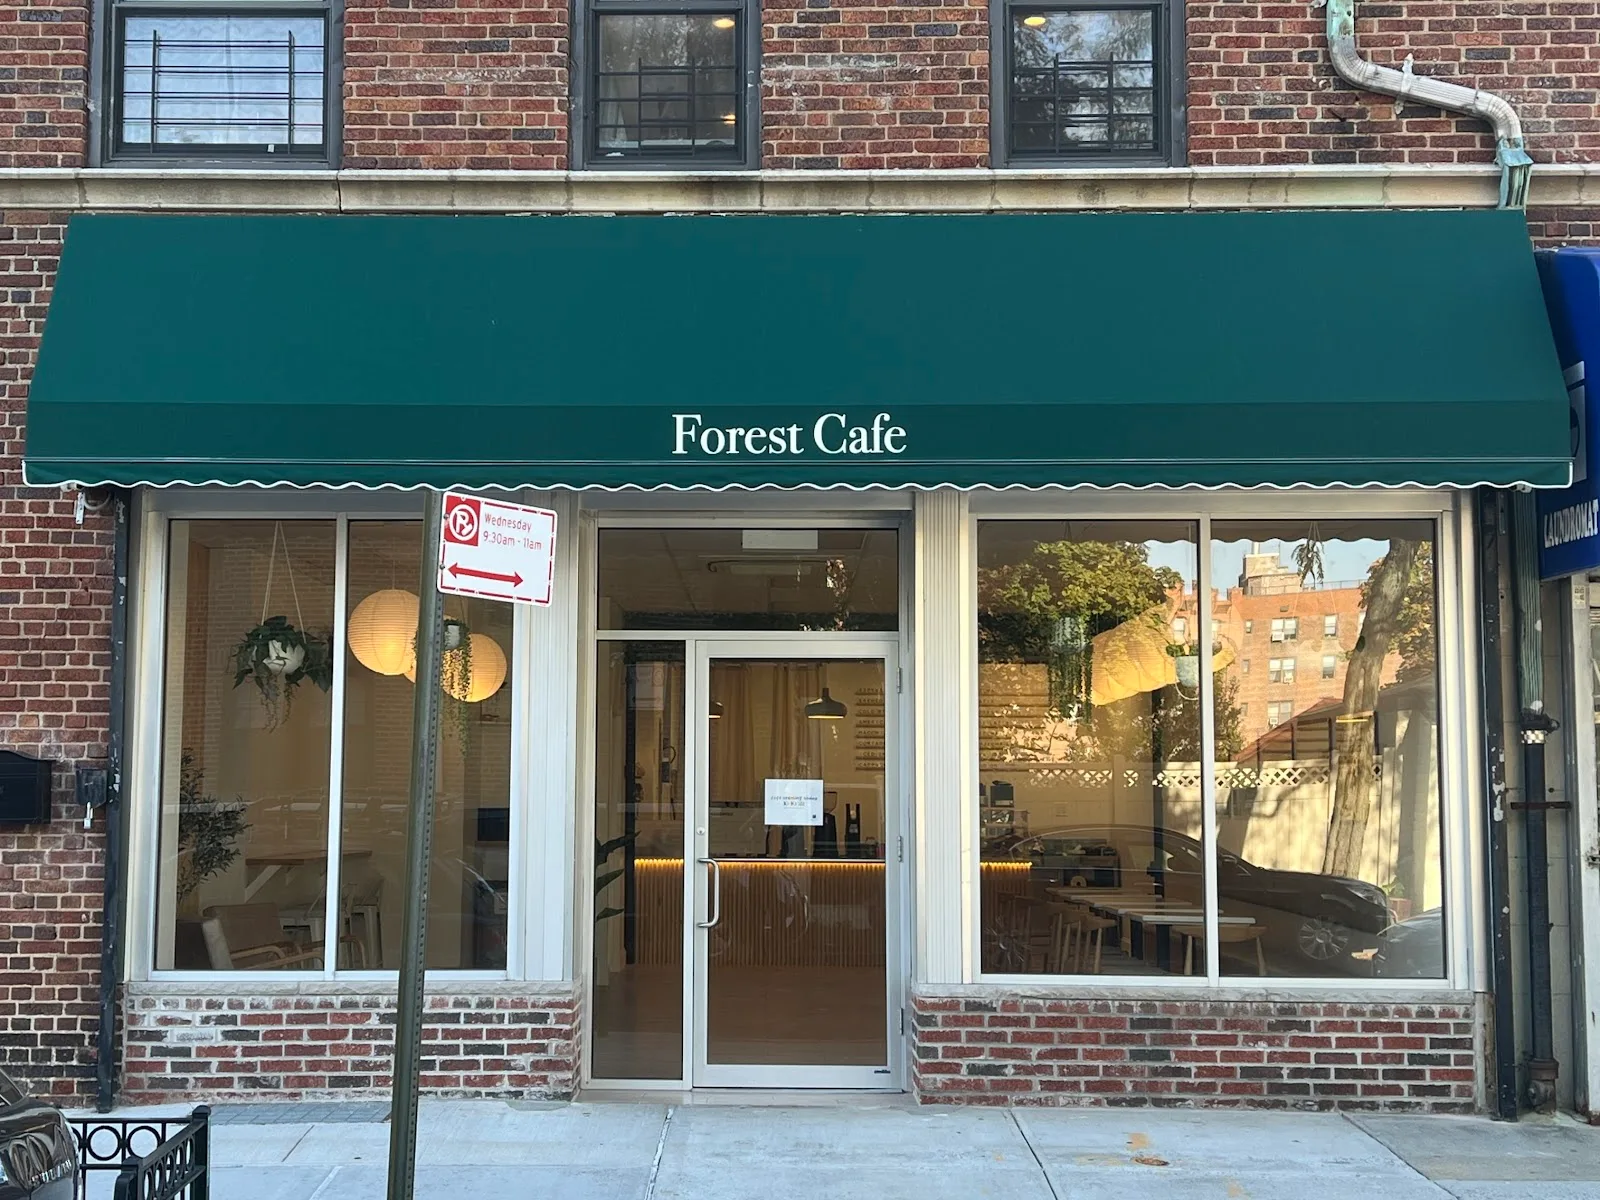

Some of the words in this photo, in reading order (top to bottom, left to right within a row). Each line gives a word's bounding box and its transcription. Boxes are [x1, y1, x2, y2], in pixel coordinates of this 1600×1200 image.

[671, 413, 805, 455] Forest
[813, 412, 907, 454] Cafe
[484, 512, 532, 533] Wednesday
[1543, 498, 1599, 549] LAUNDROMAT
[483, 530, 516, 547] 9:30am
[523, 537, 542, 550] 11am
